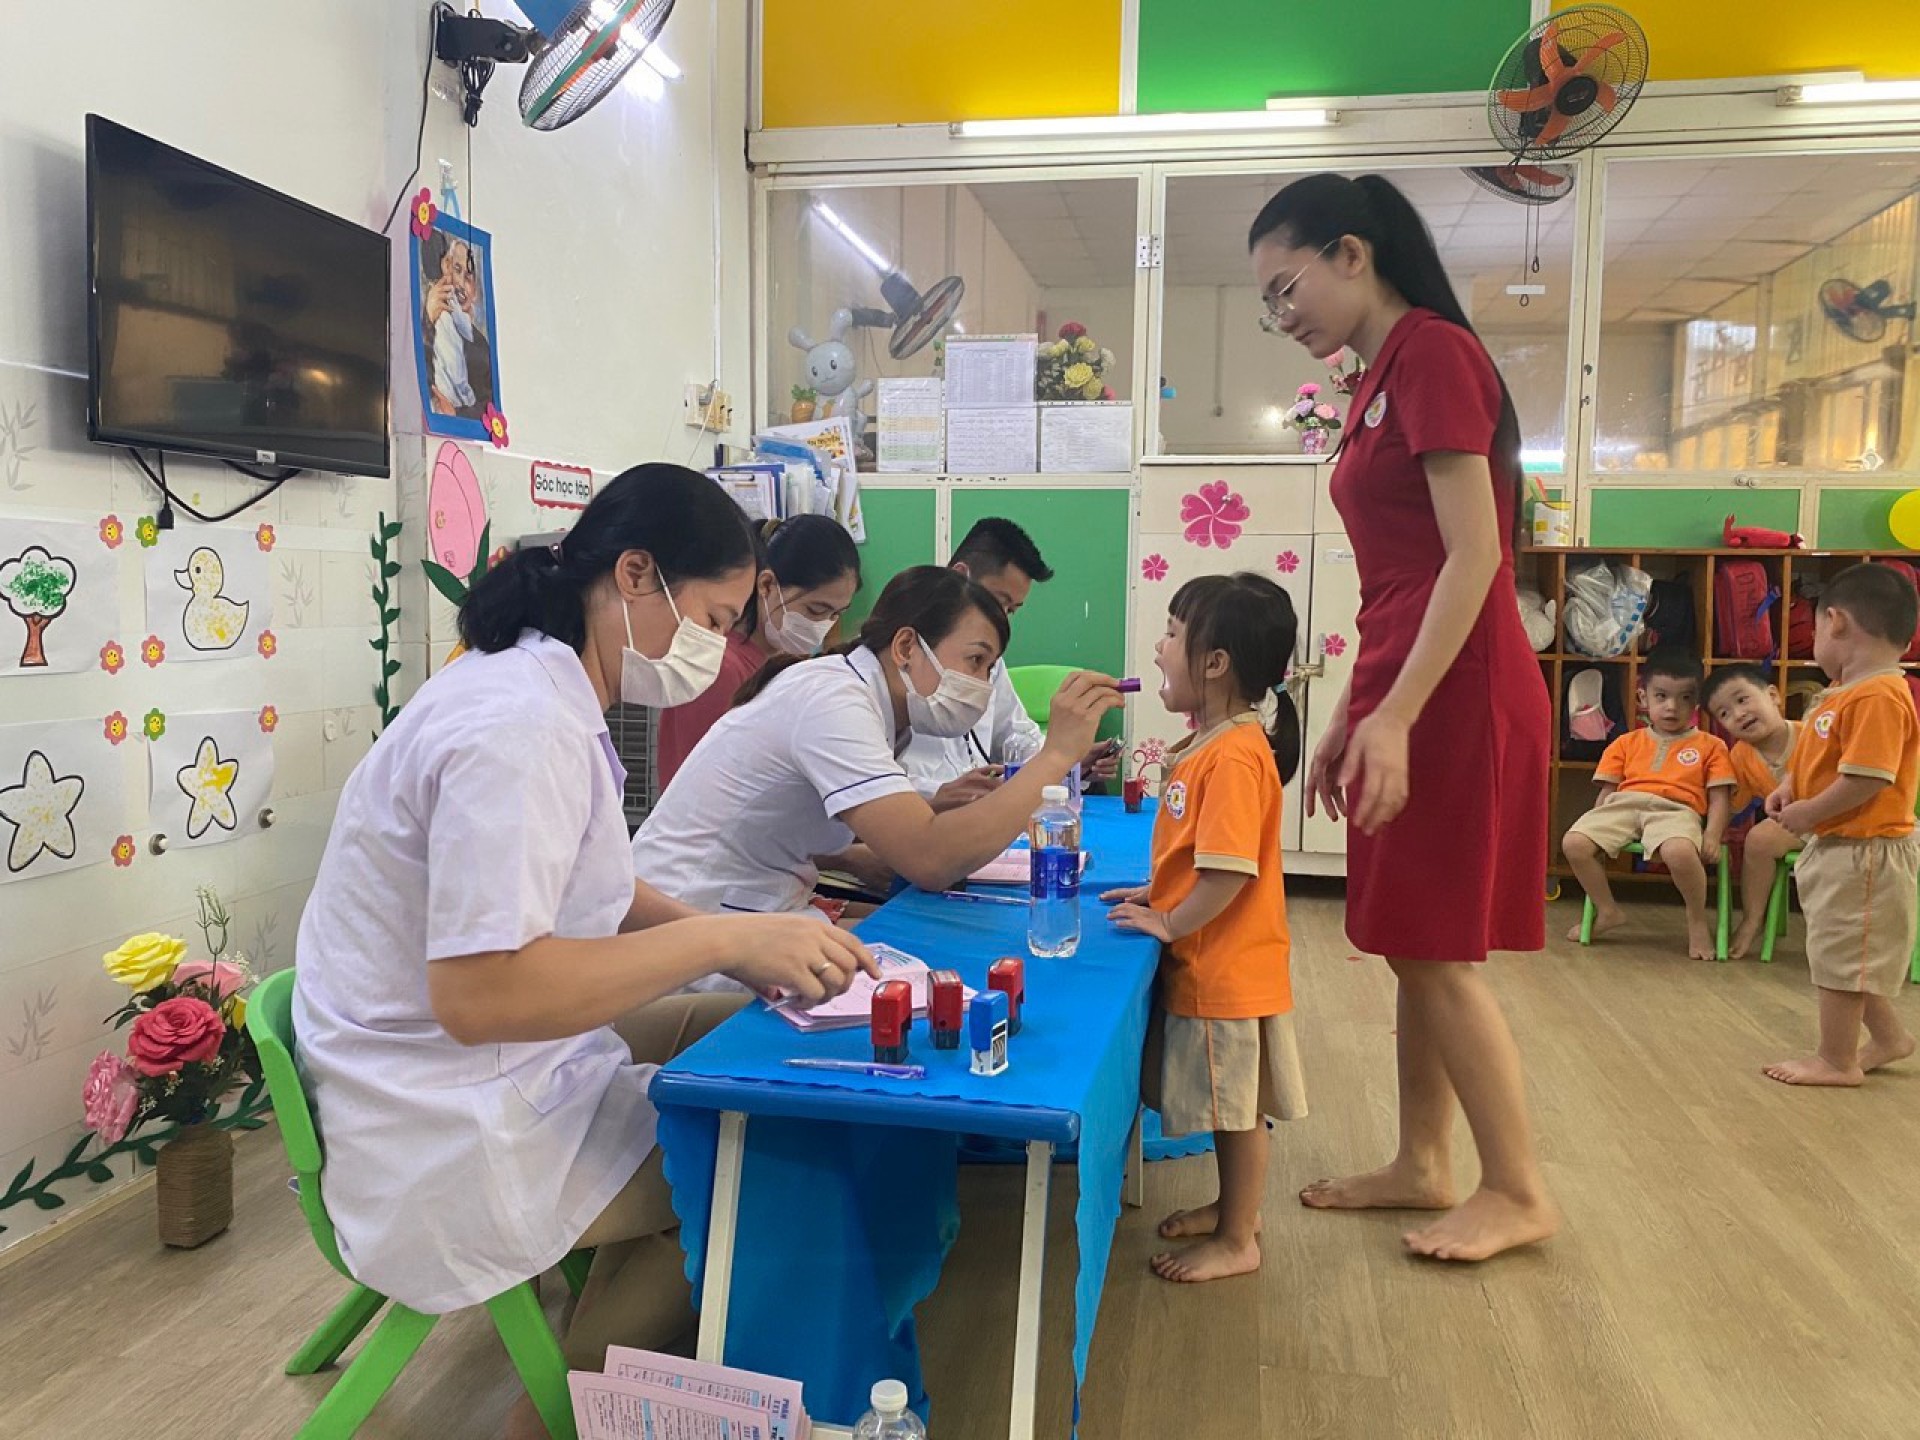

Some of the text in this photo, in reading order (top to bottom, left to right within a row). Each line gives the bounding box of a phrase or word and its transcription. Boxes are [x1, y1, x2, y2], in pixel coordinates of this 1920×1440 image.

[535, 473, 590, 499] Góc học tập
